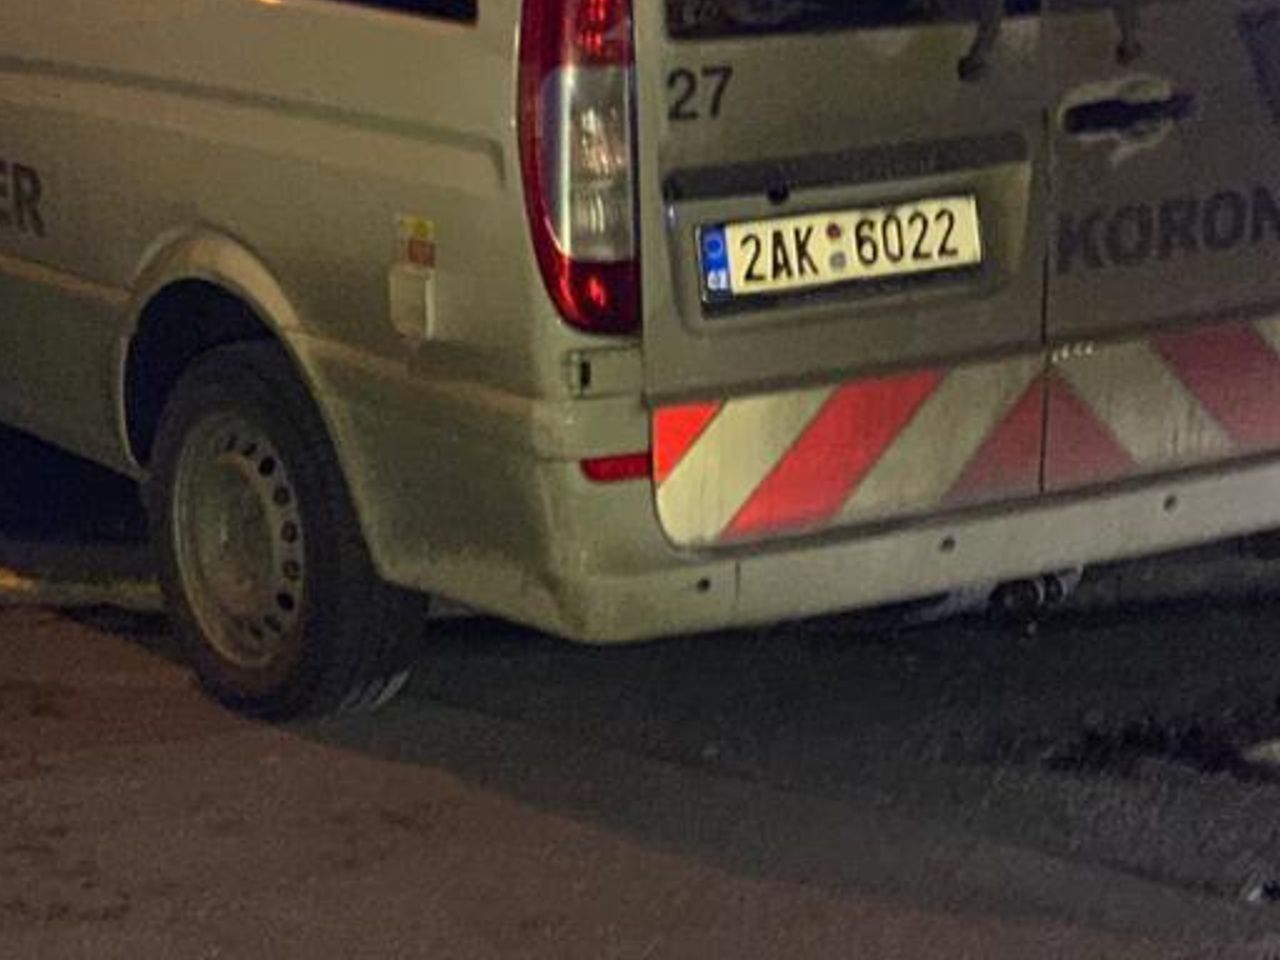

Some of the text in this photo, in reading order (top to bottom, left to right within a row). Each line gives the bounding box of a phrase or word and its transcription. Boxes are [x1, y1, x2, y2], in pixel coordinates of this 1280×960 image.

[667, 65, 733, 122] 27
[739, 208, 959, 282] 2AK 6022
